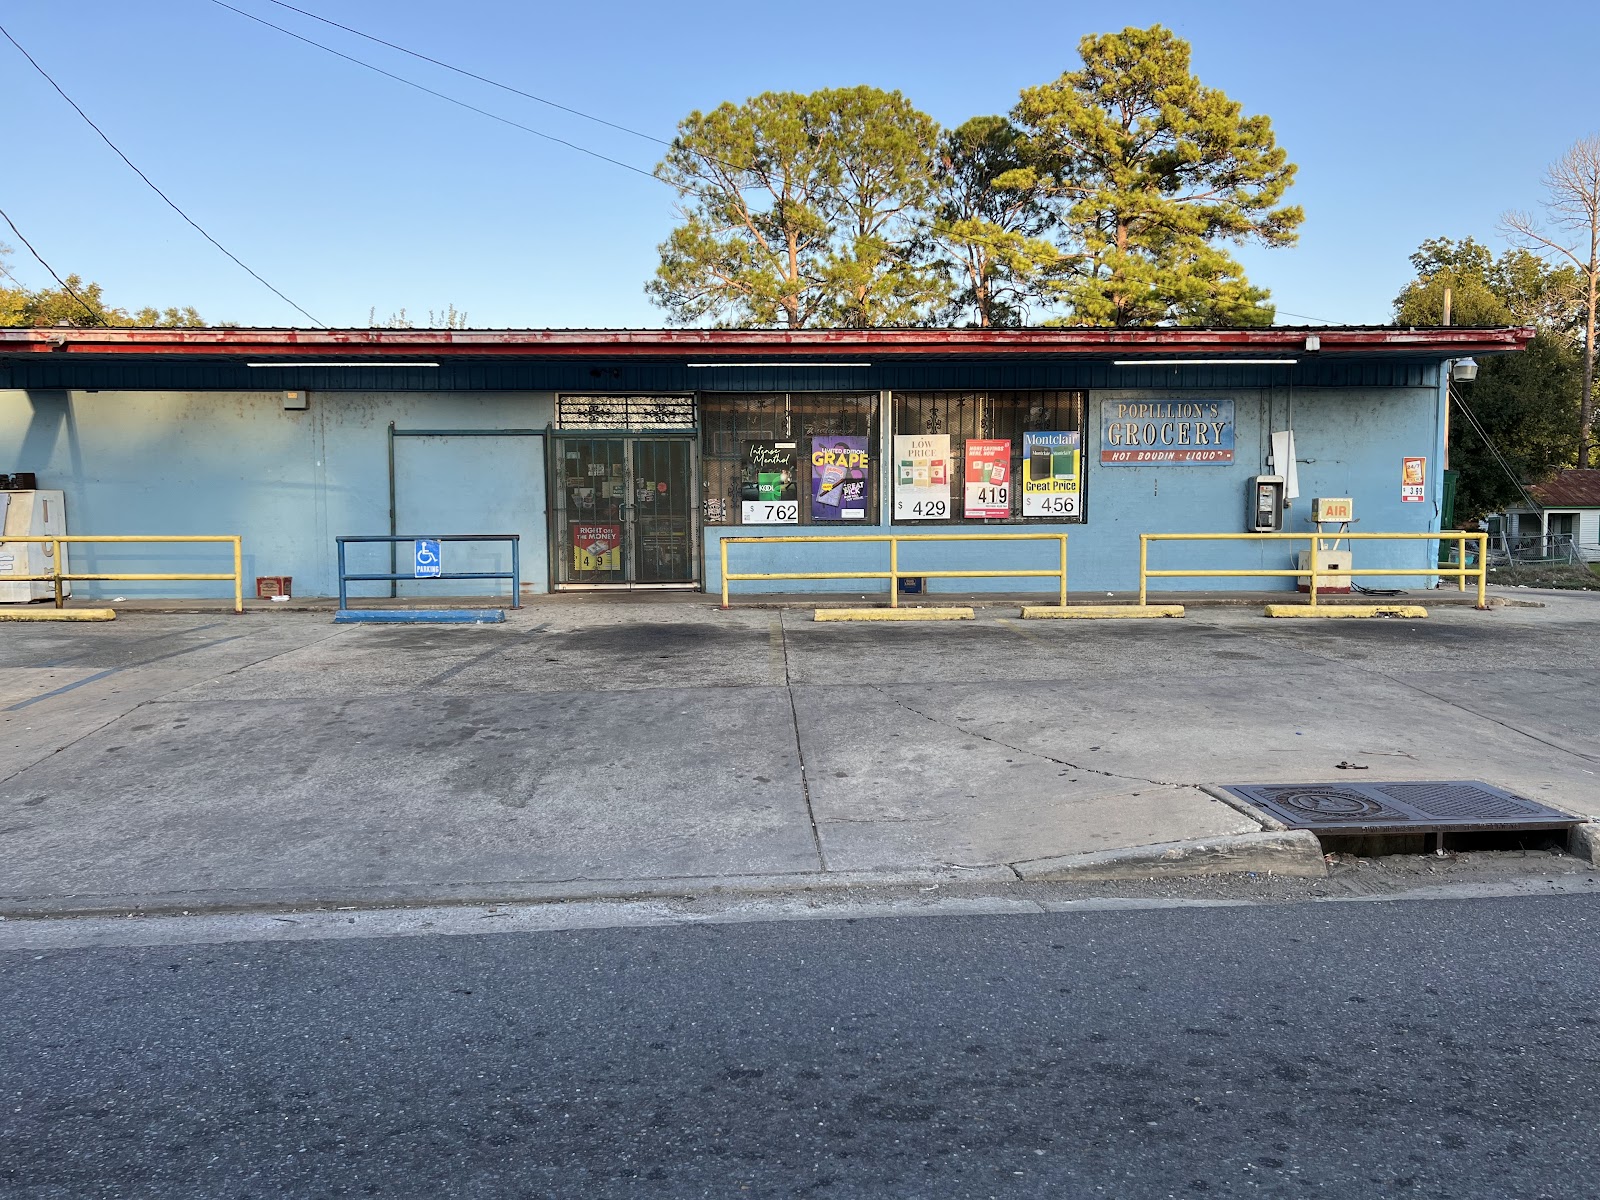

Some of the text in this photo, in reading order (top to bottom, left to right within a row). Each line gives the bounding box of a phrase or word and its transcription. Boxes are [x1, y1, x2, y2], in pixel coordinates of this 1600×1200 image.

[1118, 403, 1219, 419] POPILLION'S
[1025, 433, 1077, 445] Montclair
[1107, 422, 1226, 446] GROCERY
[911, 440, 934, 449] LOW
[749, 444, 781, 457] Intense
[908, 449, 937, 458] PRICE
[753, 453, 791, 467] Menthol
[811, 451, 869, 469] GRAPE
[1111, 452, 1132, 461] HOT
[1137, 452, 1176, 461] BOUDIN
[1026, 481, 1076, 492] Great Price
[1325, 505, 1347, 516] AIR
[416, 565, 440, 573] PARKING
